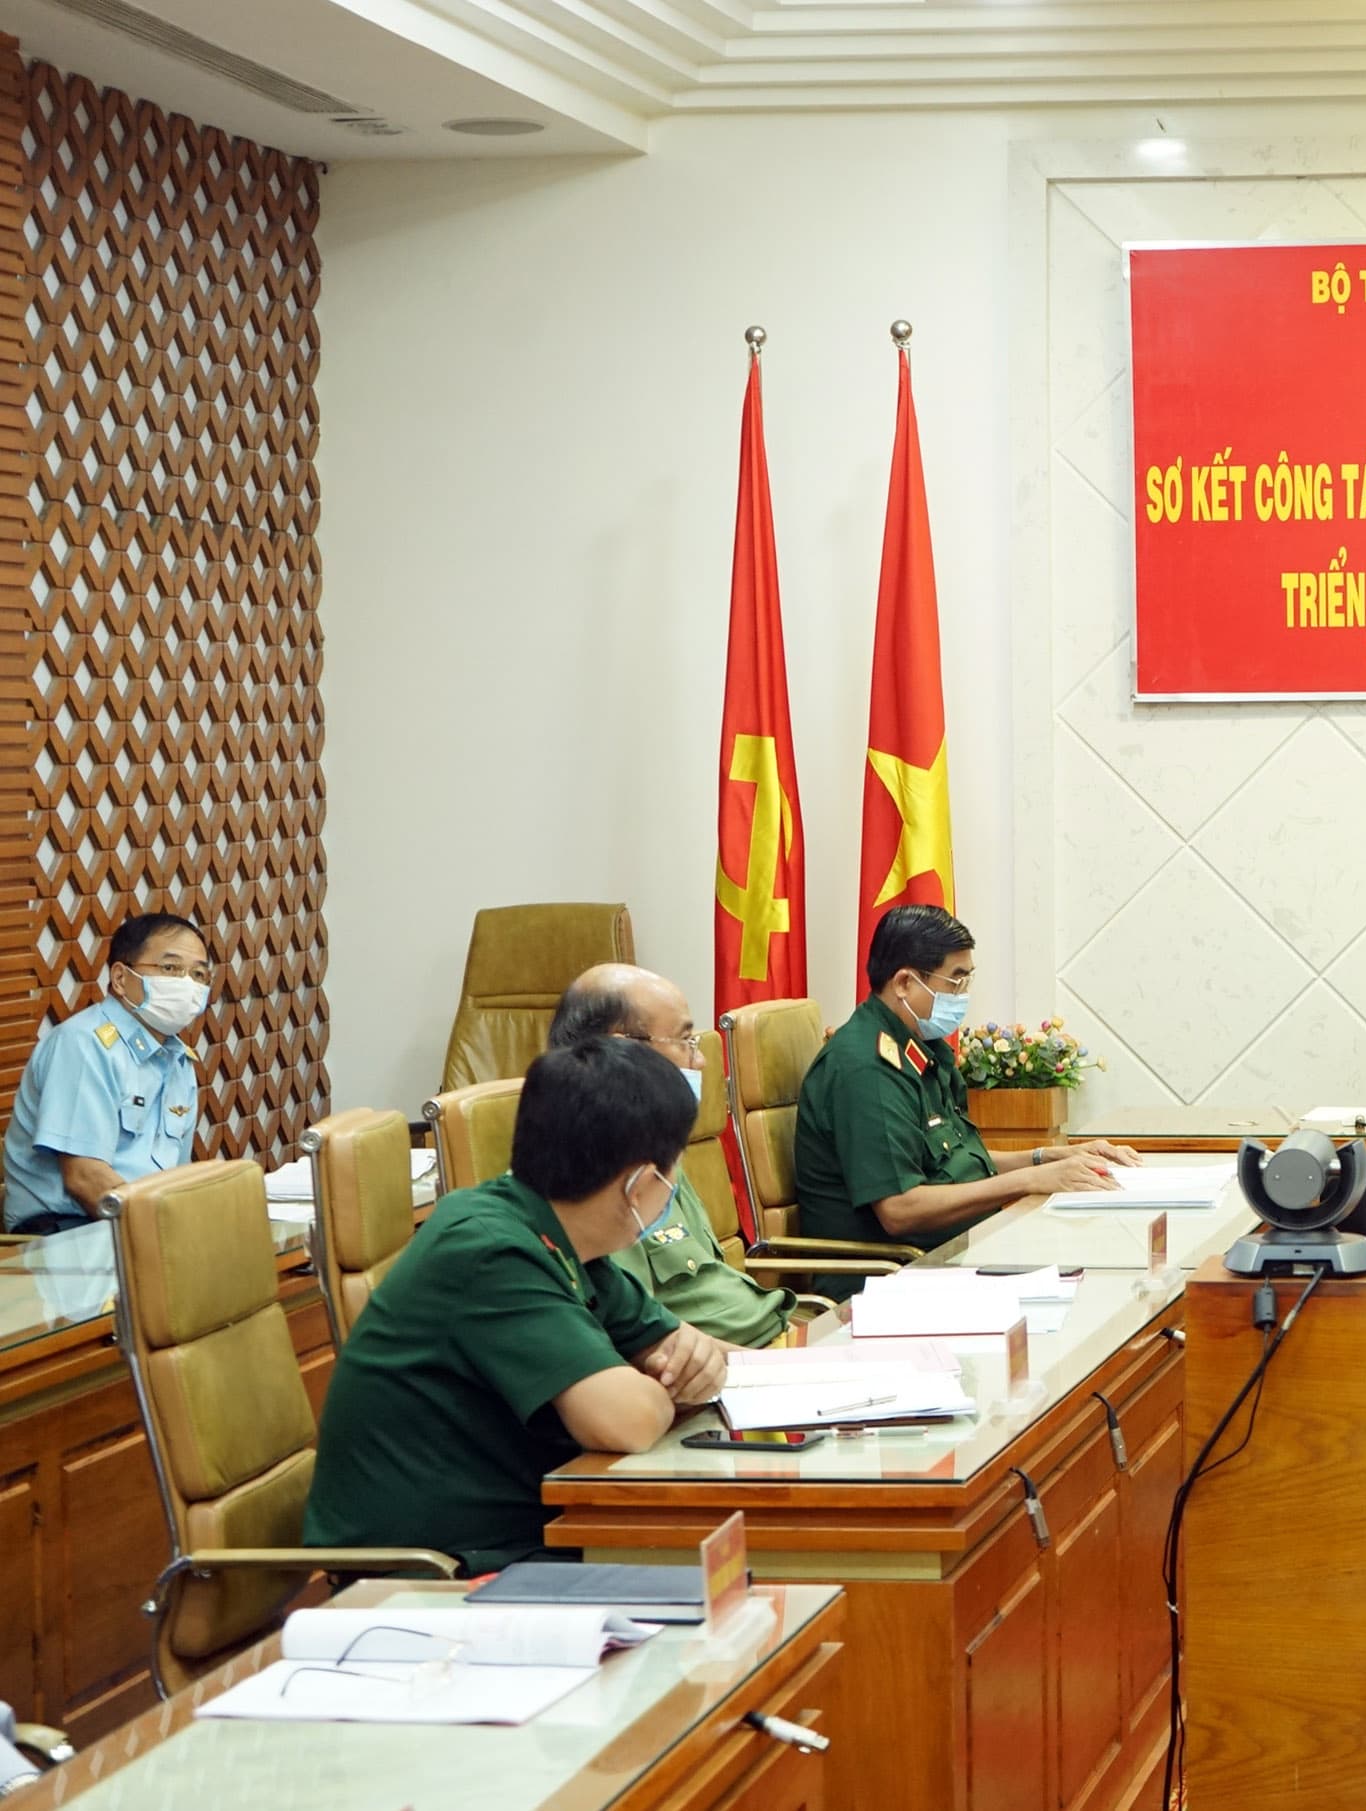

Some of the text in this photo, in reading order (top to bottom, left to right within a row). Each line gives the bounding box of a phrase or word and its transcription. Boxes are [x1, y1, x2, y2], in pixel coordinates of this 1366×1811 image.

[1312, 262, 1351, 314] BỘ
[1146, 456, 1183, 523] SƠ
[1191, 447, 1246, 521] KẾT
[1254, 451, 1333, 521] CÔNG
[1281, 546, 1366, 627] TRIỂN
